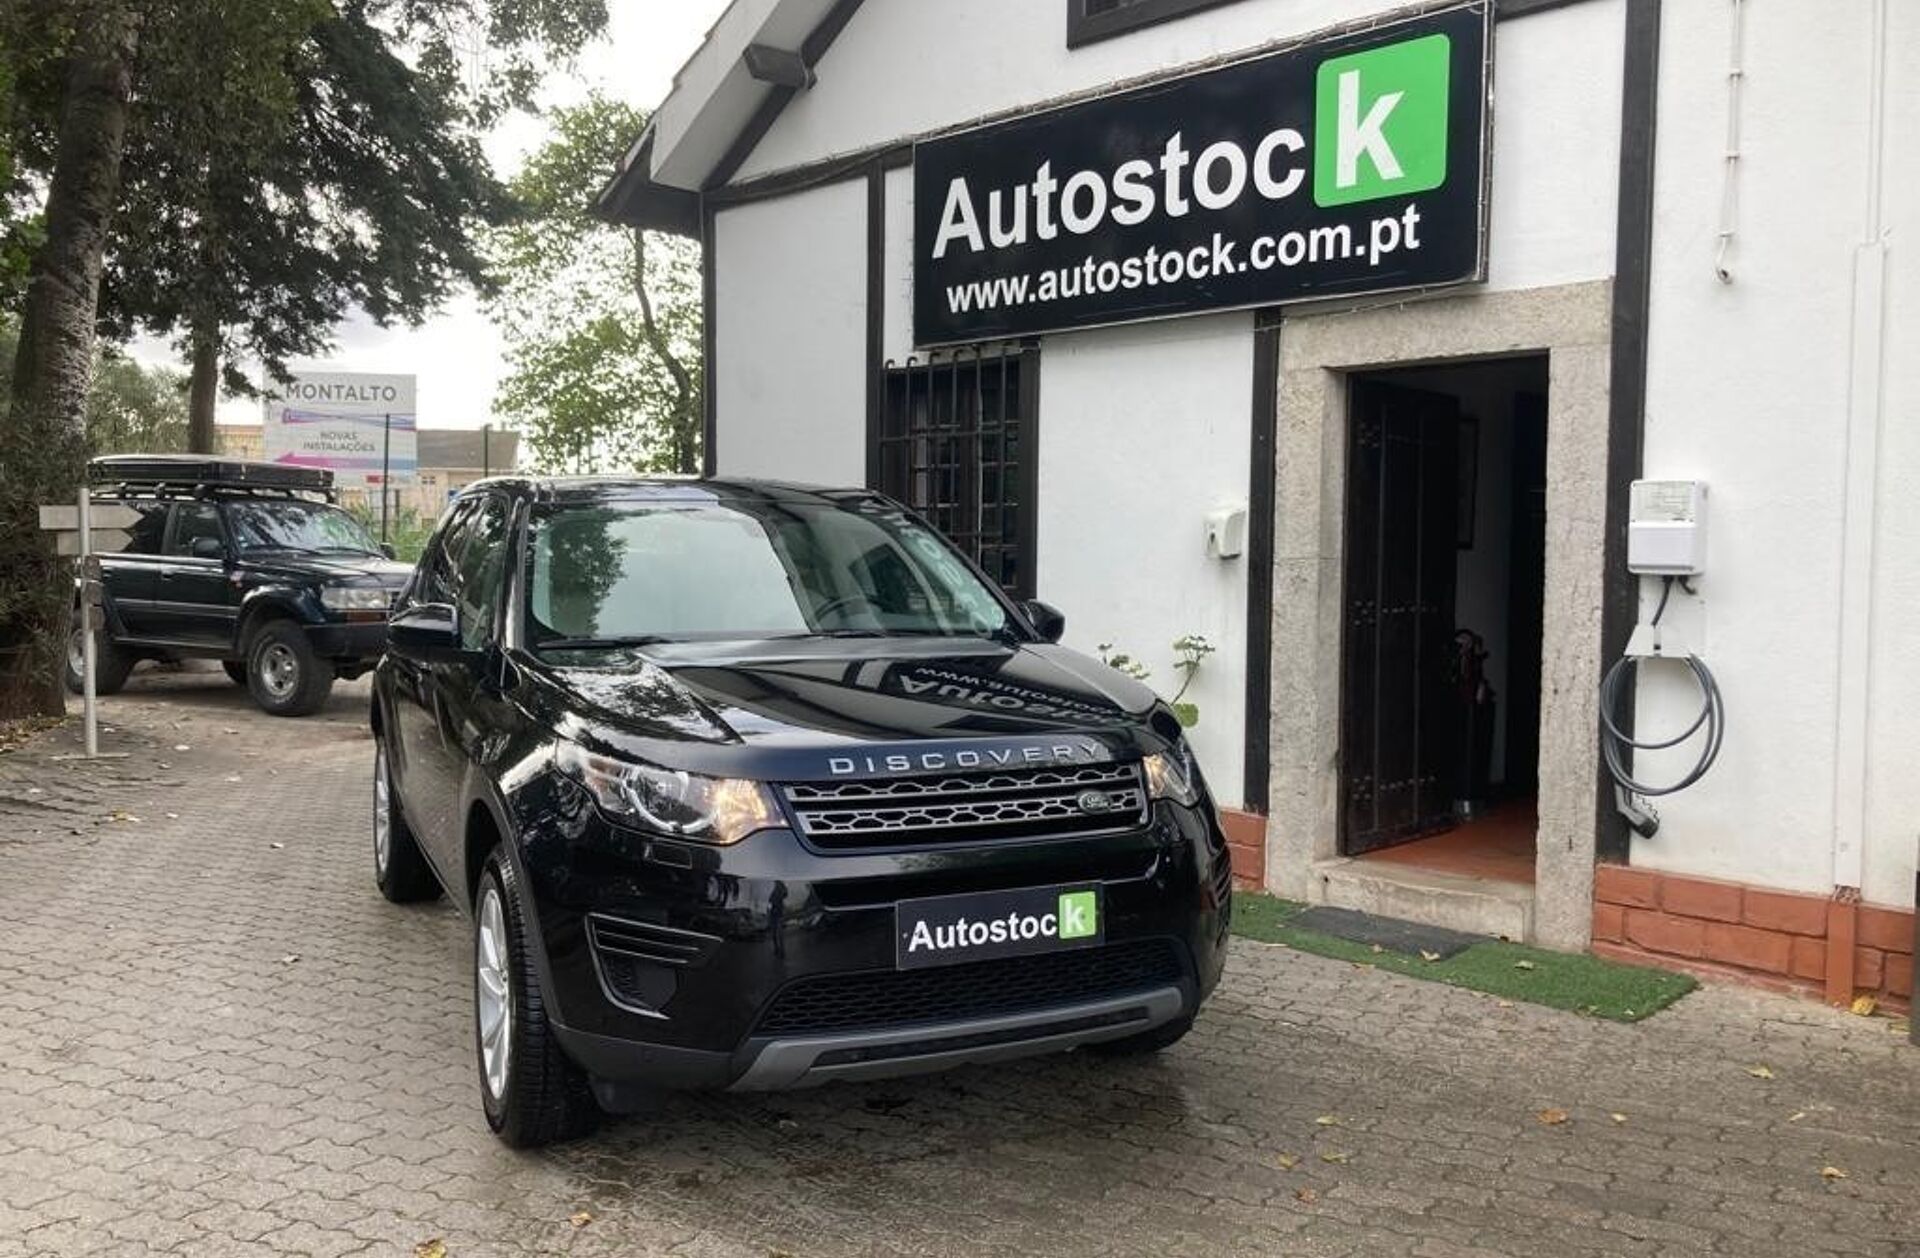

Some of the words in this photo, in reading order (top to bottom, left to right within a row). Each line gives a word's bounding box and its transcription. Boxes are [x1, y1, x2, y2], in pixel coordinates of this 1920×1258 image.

[932, 69, 1405, 258] Autostock
[947, 203, 1421, 313] www.autostock.com.pt
[286, 384, 397, 401] MONTALTO
[829, 745, 1098, 775] DISCOVERY
[908, 898, 1086, 952] Autostock
